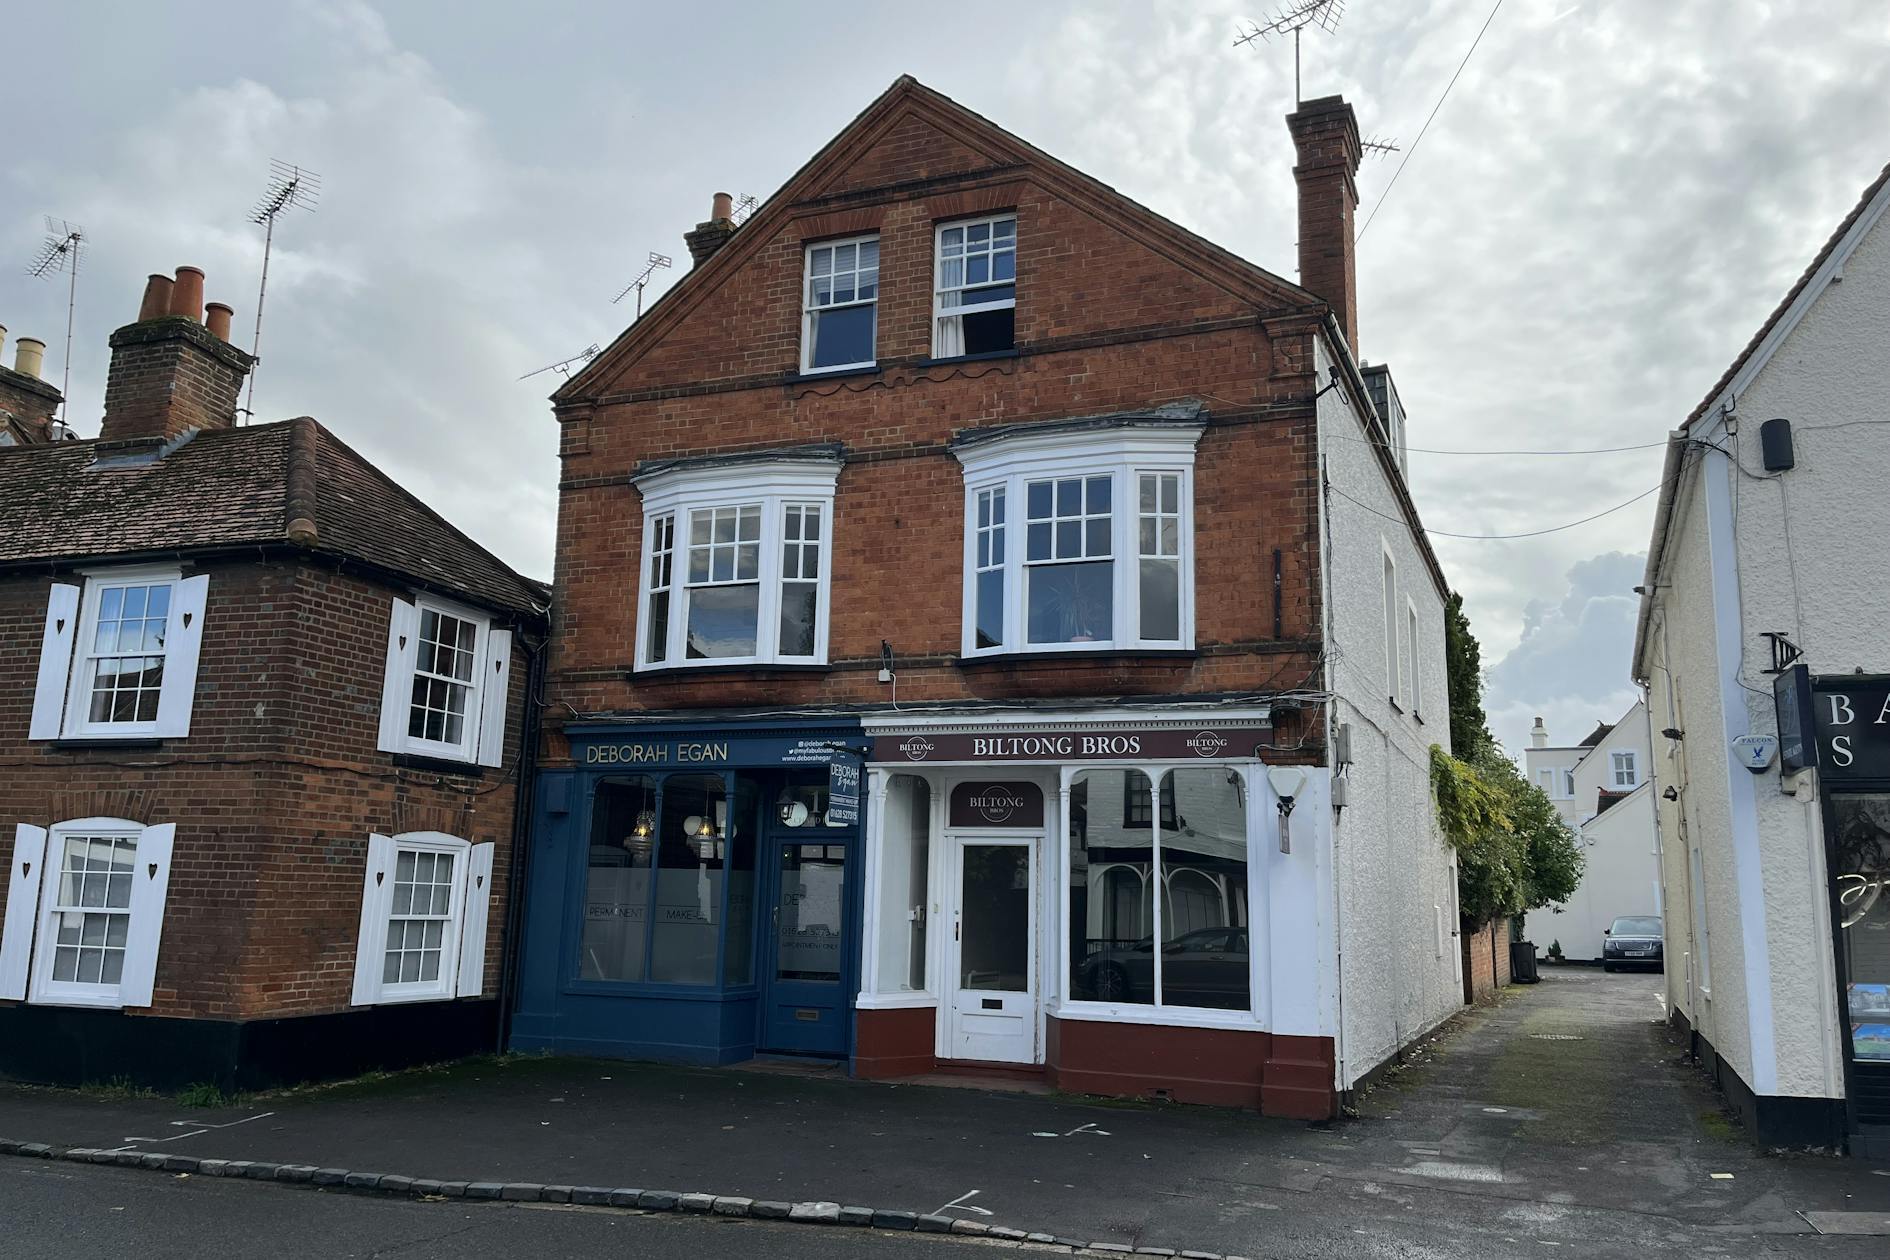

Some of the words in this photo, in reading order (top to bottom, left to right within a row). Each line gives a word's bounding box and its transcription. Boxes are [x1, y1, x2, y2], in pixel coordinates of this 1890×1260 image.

[899, 744, 935, 752] BILTONG
[973, 736, 1072, 756] BILTONG
[1081, 735, 1141, 755] BROS
[1186, 738, 1228, 747] BILTONG
[586, 745, 668, 764] DEBORAH
[677, 743, 728, 762] EGAN
[1831, 736, 1854, 767] S
[831, 763, 860, 779] DEBORAH
[969, 797, 1024, 808] BILTONG
[589, 908, 643, 918] PERMNENT
